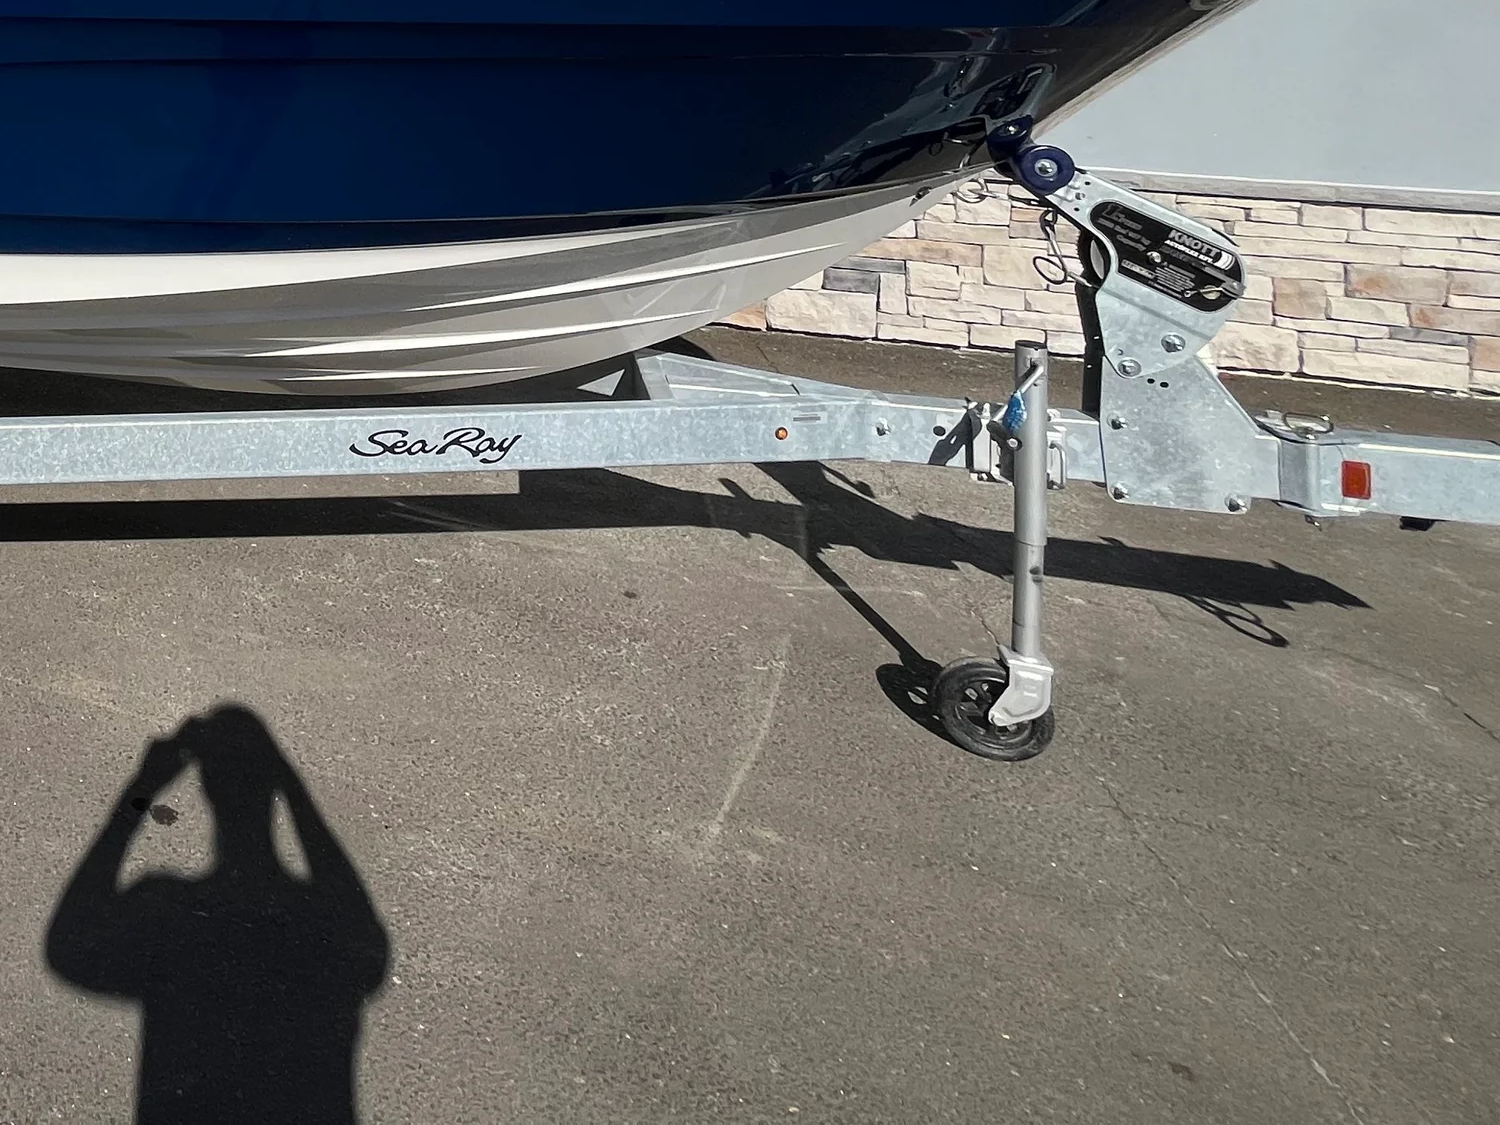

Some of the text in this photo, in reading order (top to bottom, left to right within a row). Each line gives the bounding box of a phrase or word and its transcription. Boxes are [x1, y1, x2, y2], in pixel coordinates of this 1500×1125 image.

[1168, 229, 1221, 257] KNOTT
[349, 427, 522, 463] Sea Ray
